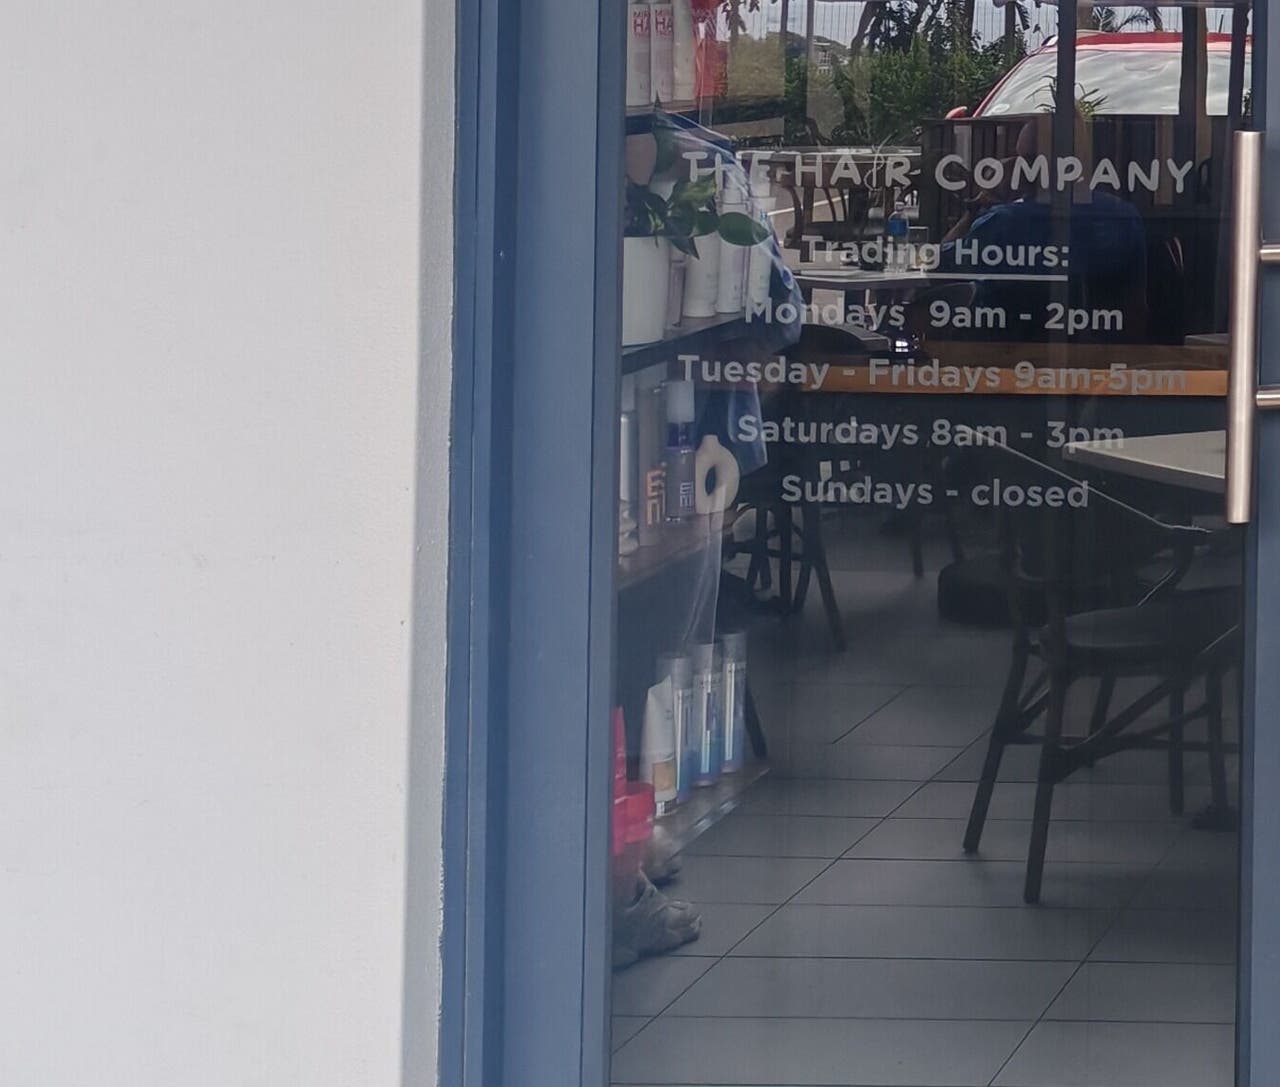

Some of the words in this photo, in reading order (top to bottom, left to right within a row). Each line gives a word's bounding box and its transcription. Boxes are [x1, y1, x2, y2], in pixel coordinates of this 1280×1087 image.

[682, 150, 774, 192] THE
[795, 144, 912, 191] HAIR
[934, 153, 1194, 194] COMPANY
[804, 236, 942, 270] Trading
[954, 237, 1070, 268] Hours:
[745, 298, 906, 331] Mondays
[929, 300, 1008, 329] 9am
[1044, 303, 1124, 335] 2pm
[678, 354, 830, 387] Tuesday
[868, 358, 1002, 392] Fridays
[736, 415, 919, 449] Saturdays
[931, 417, 1008, 445] 8am
[1047, 420, 1125, 453] 3pm
[781, 474, 933, 508] Sundays
[971, 479, 1089, 509] closed
